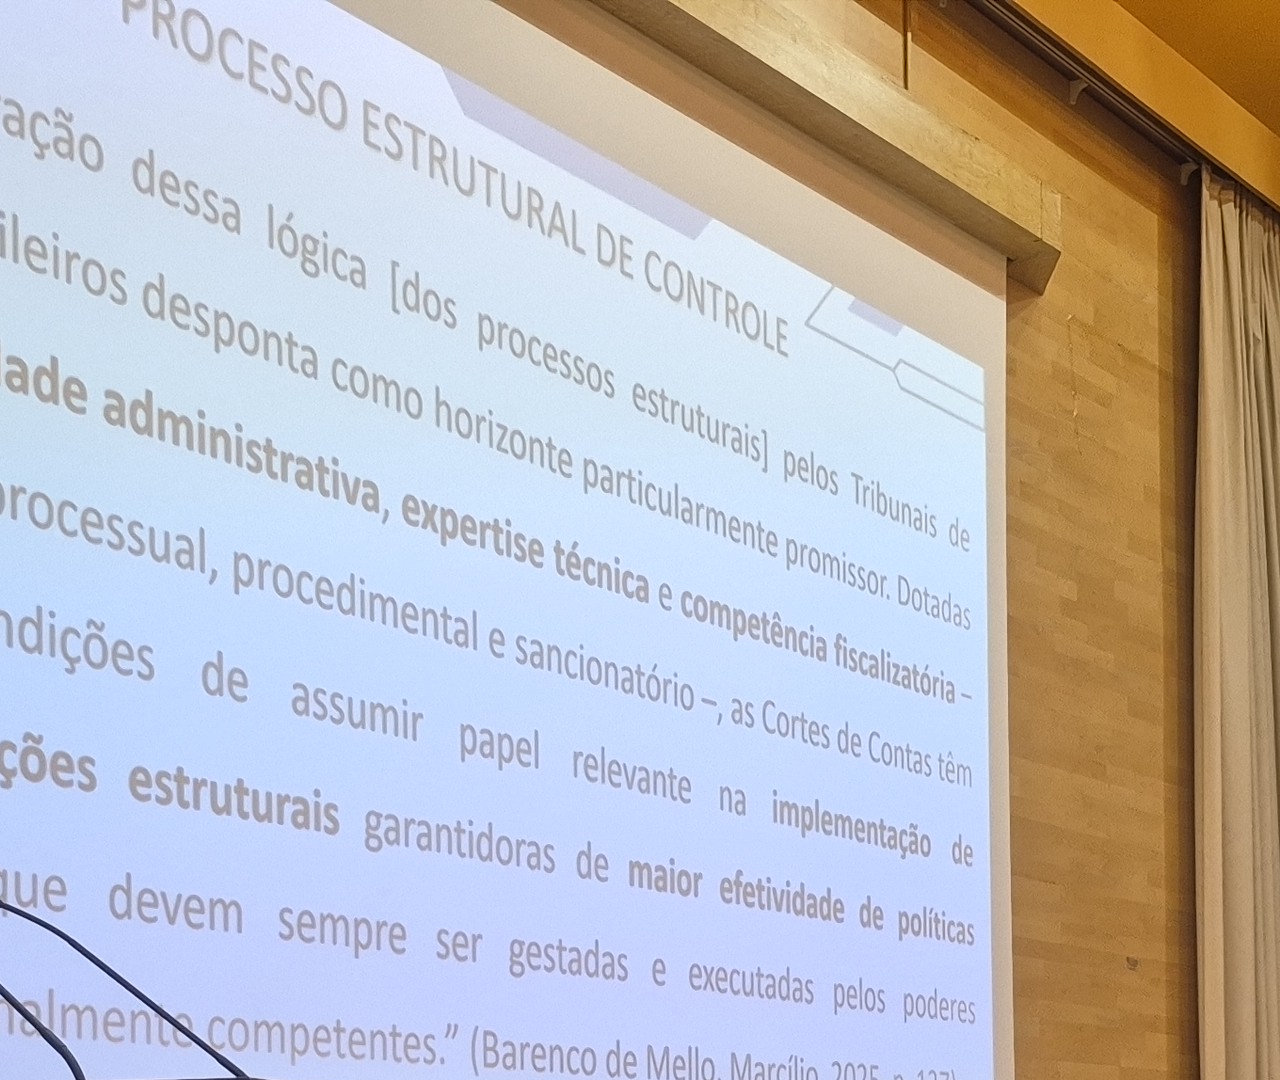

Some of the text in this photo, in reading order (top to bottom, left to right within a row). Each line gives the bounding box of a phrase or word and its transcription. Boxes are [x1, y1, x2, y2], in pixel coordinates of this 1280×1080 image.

[363, 100, 586, 255] ESTRUTURAL
[597, 223, 633, 280] DE
[645, 251, 788, 357] CONTROLE
[132, 149, 240, 235] dessa
[268, 204, 366, 290] lógica
[391, 260, 457, 329] [dos
[478, 313, 615, 398] processos
[632, 383, 768, 473] estruturais]
[784, 450, 838, 495] pelos
[851, 472, 937, 538] Tribunais
[949, 518, 969, 552] de
[143, 273, 318, 380] desponta
[332, 358, 423, 419] como
[435, 386, 573, 478] horizonte
[583, 458, 778, 557] particularmente
[786, 538, 890, 598] promissor.
[898, 575, 970, 630] Dotadas
[103, 389, 389, 524] administrativa,
[402, 494, 544, 568] expertise
[553, 540, 649, 603] técnica
[659, 583, 672, 611] e
[681, 591, 827, 662] competência
[834, 633, 955, 703] fiscalizatória
[202, 651, 248, 703] de
[292, 683, 423, 741] assumir
[460, 724, 539, 771] papel
[573, 746, 691, 804] relevante
[720, 786, 746, 816] na
[773, 791, 931, 859] implementação
[952, 834, 973, 867] de
[234, 551, 477, 650] procedimental
[489, 628, 505, 658] e
[516, 635, 694, 711] sancionatório
[731, 698, 754, 728] as
[762, 700, 830, 749] Cortes
[837, 722, 861, 758] de
[868, 731, 932, 777] Contas
[938, 753, 972, 787] têm
[109, 872, 242, 933] devem
[279, 907, 406, 959] sempre
[436, 929, 483, 962] ser
[509, 939, 628, 981] gestadas
[652, 959, 666, 986] e
[689, 963, 814, 1004] executadas
[834, 978, 885, 1015] pelos
[904, 988, 975, 1024] poderes
[129, 766, 339, 835] estruturais
[365, 810, 555, 873] garantidoras
[576, 841, 609, 882] de
[629, 858, 703, 898] maior
[720, 869, 844, 923] efetividade
[859, 895, 883, 930] de
[898, 906, 974, 946] políticas
[208, 1016, 459, 1067] competentes.”
[471, 1026, 596, 1076] (Barenco
[606, 1040, 637, 1079] de
